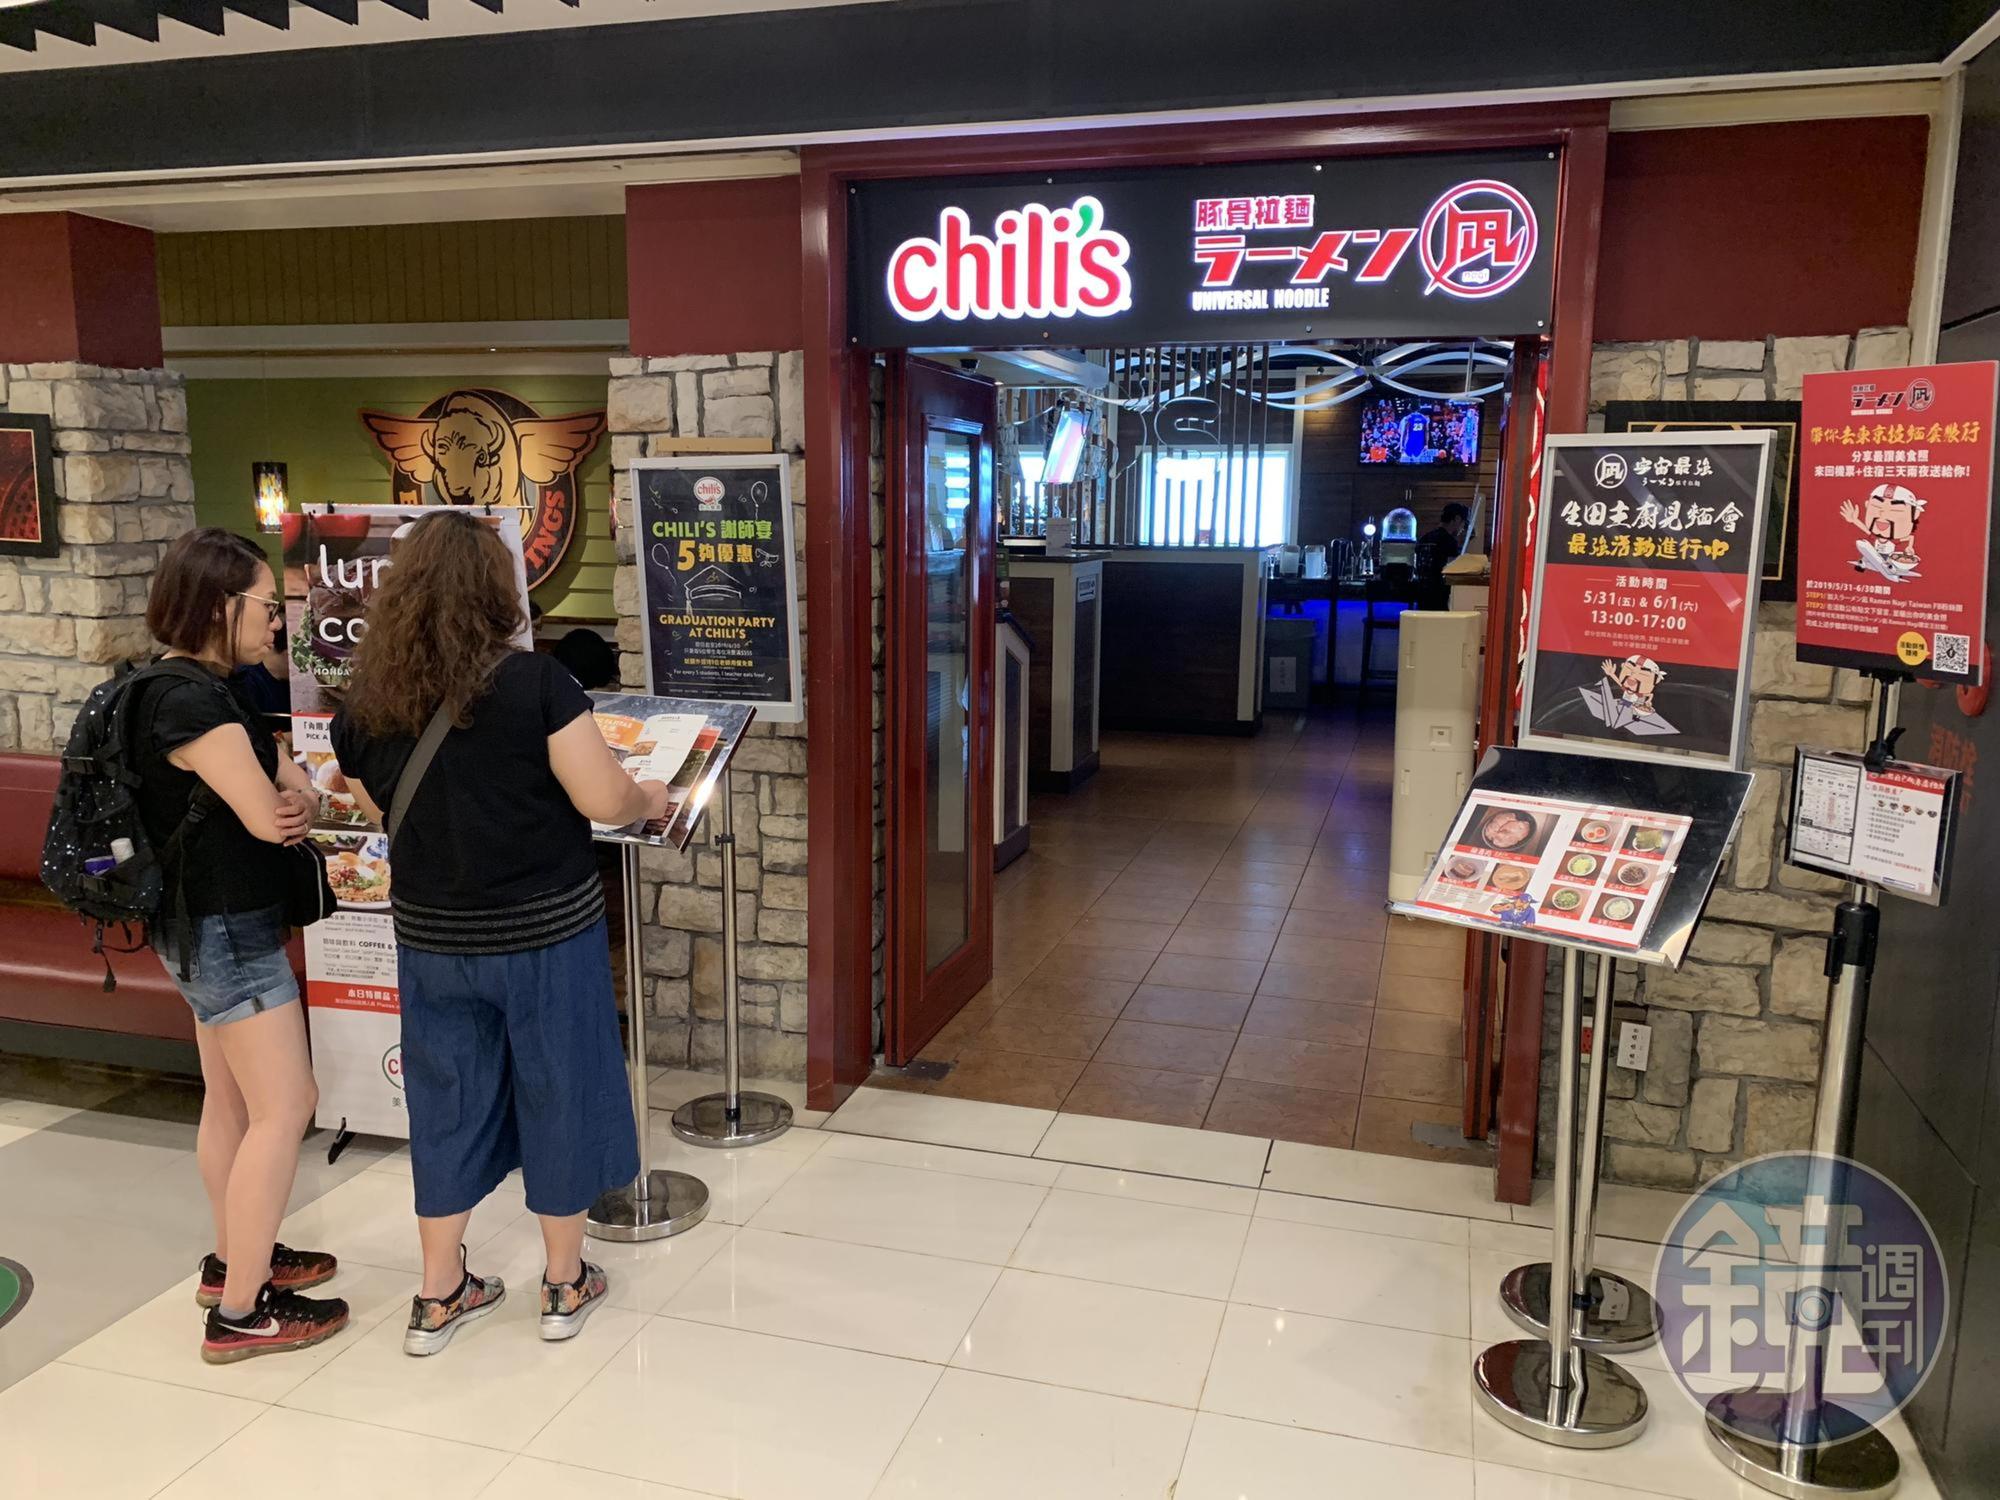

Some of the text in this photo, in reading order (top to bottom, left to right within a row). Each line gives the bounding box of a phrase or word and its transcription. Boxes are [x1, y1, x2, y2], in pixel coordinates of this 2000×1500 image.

[1195, 195, 1314, 231] 豚骨拉麵
[888, 196, 1131, 321] chili's
[1195, 229, 1419, 286] ラーメン
[1192, 288, 1330, 311] UNIVERSAL NOODLE
[1412, 422, 1423, 431] 23
[525, 490, 565, 569] INGS
[652, 519, 772, 540] CHILI'S 謝師宴
[1567, 533, 1730, 560] 最強活動進行中
[1615, 575, 1668, 590] 活動時間
[1639, 597, 1649, 608] &
[659, 614, 775, 628] GRADUATION PARTY
[1591, 610, 1687, 630] 13:00-17:00
[689, 627, 746, 639] AT CHILI'S
[358, 940, 386, 949] COFFEE
